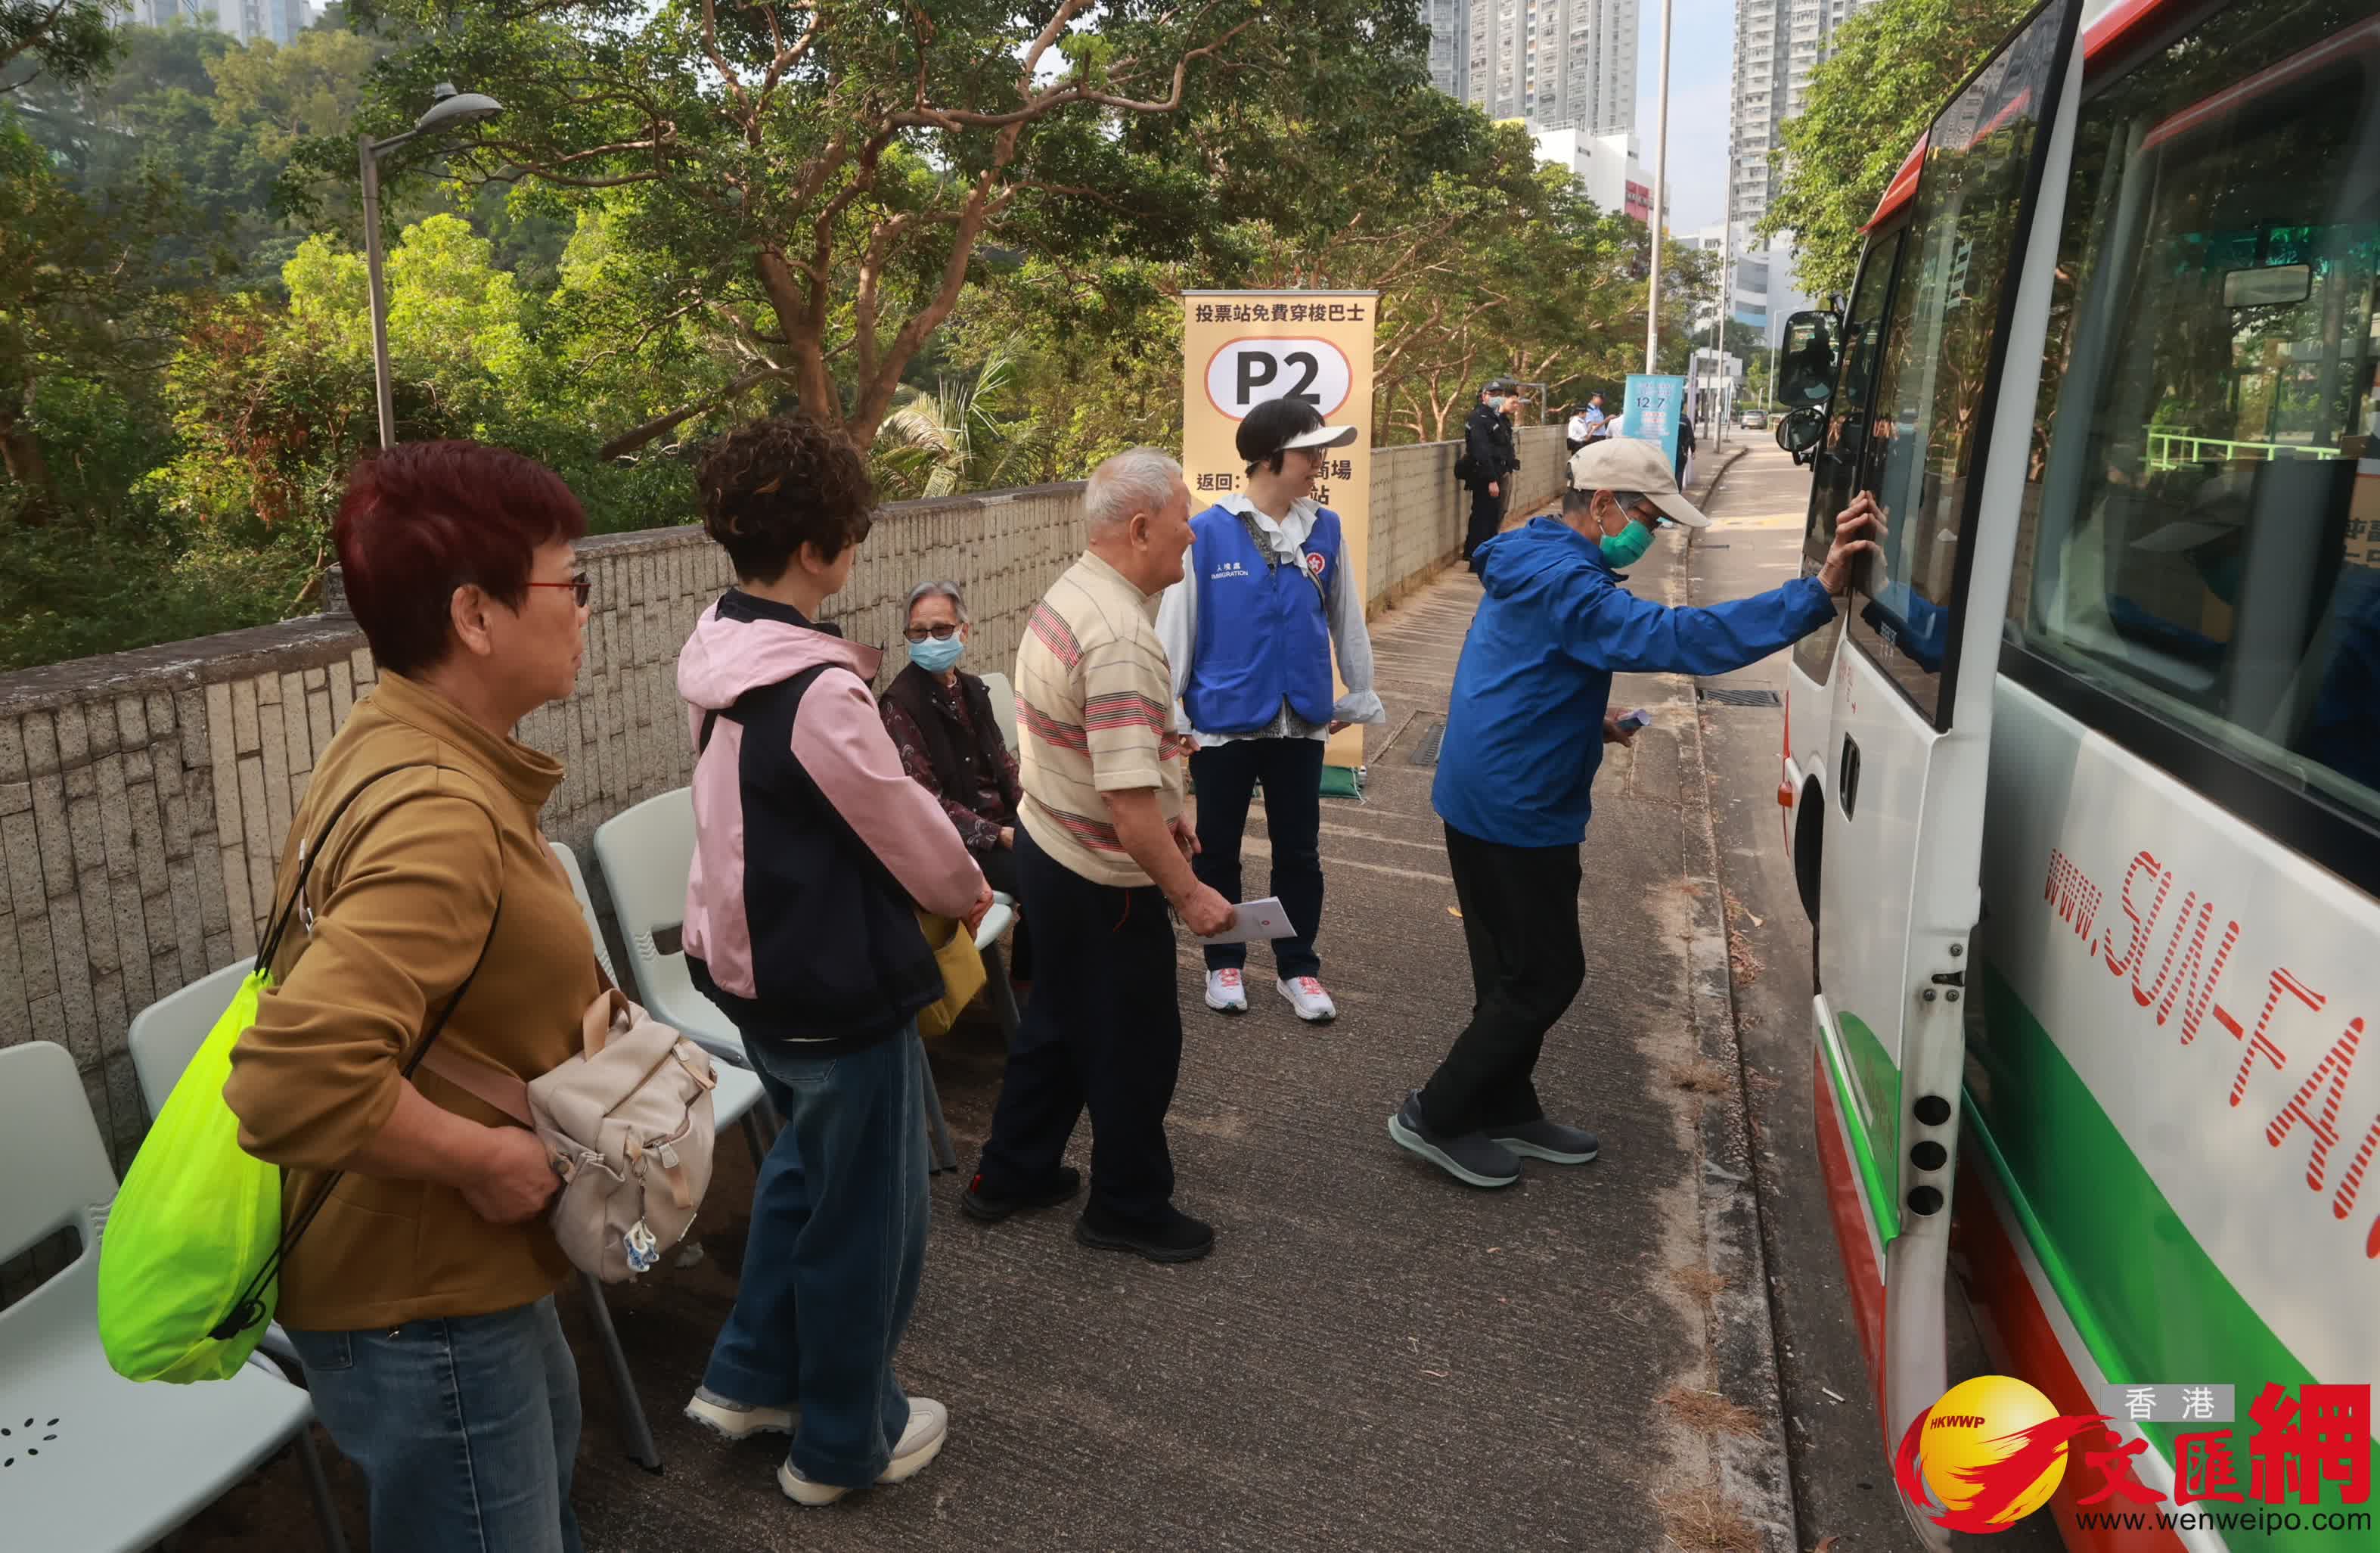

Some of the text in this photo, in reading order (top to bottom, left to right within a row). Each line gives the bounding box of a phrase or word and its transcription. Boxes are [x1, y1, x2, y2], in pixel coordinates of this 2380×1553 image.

[1196, 304, 1365, 323] 投票站免費穿梭巴士
[1237, 351, 1320, 405] P2
[1637, 397, 1650, 408] 12
